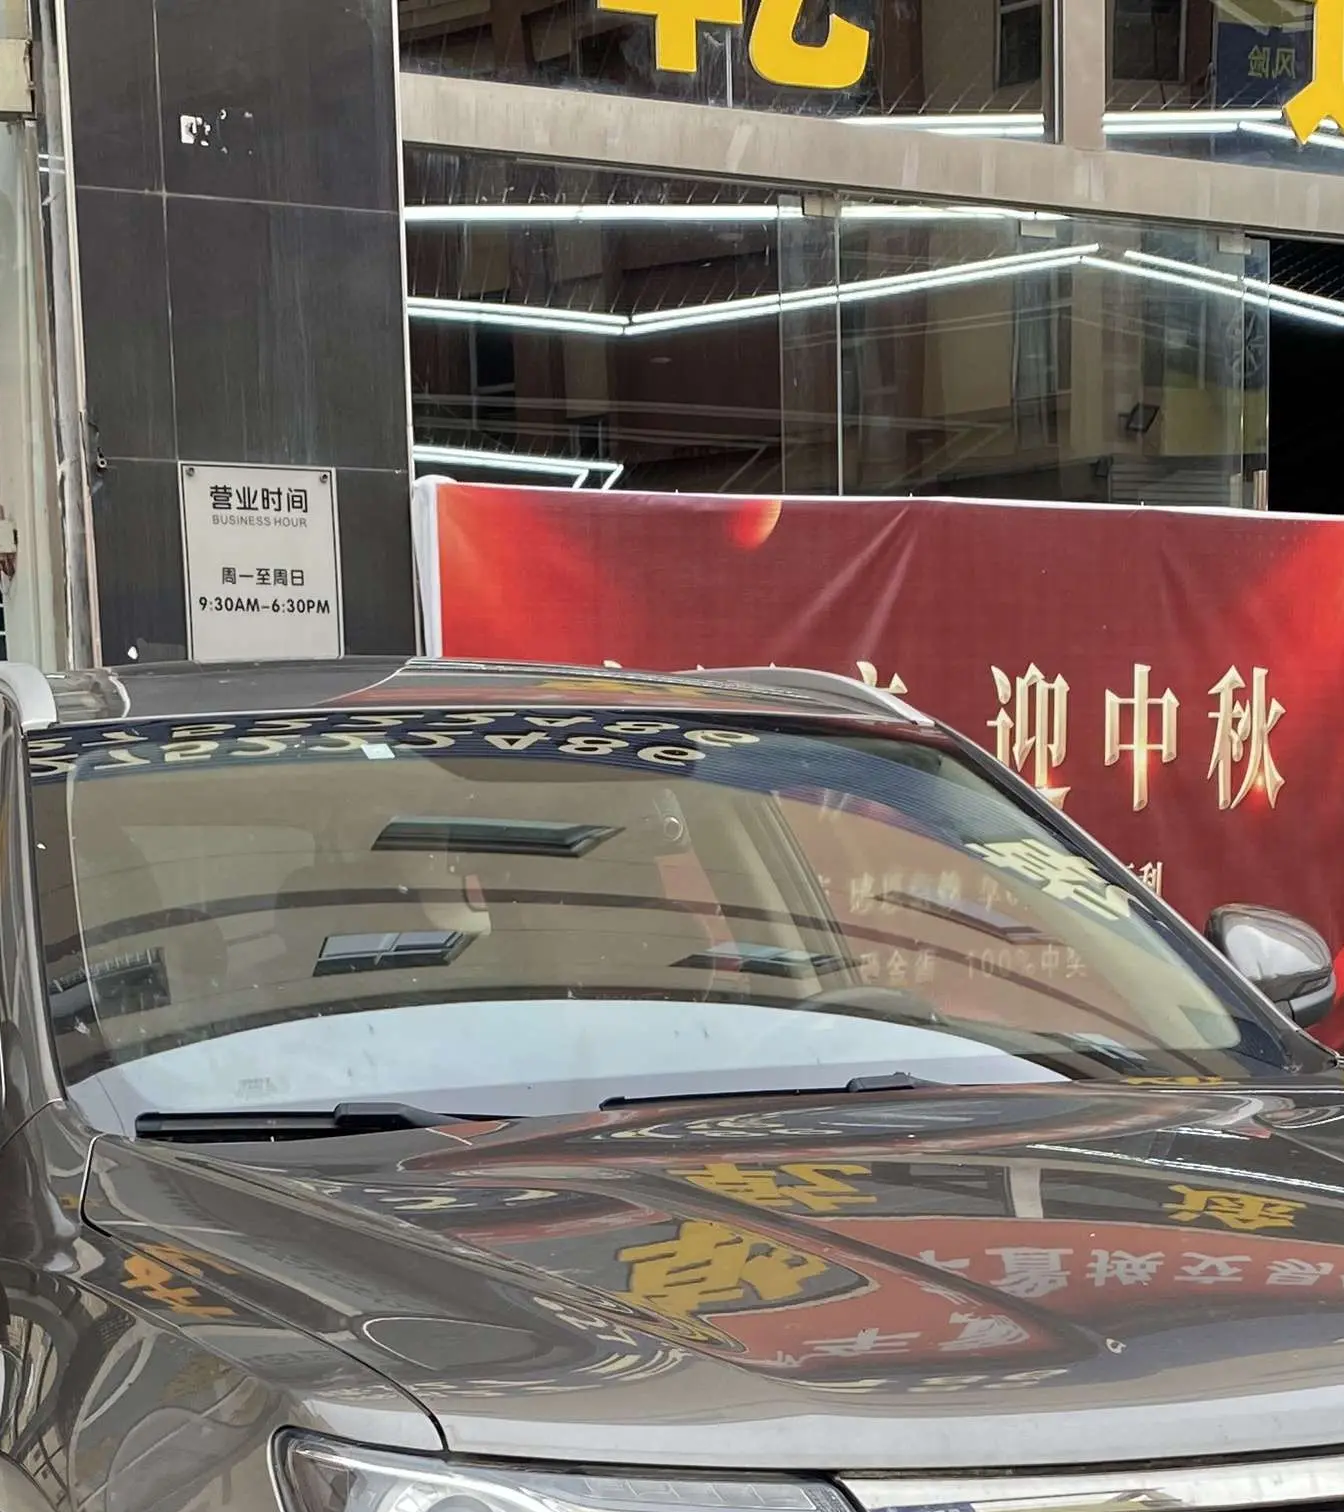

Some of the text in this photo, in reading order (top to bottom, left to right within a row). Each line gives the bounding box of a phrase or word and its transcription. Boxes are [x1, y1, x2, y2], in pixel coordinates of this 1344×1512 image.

[209, 484, 309, 513] 营业时间
[212, 514, 308, 528] BUSINESS HOUR
[221, 566, 305, 586] 周一至周日
